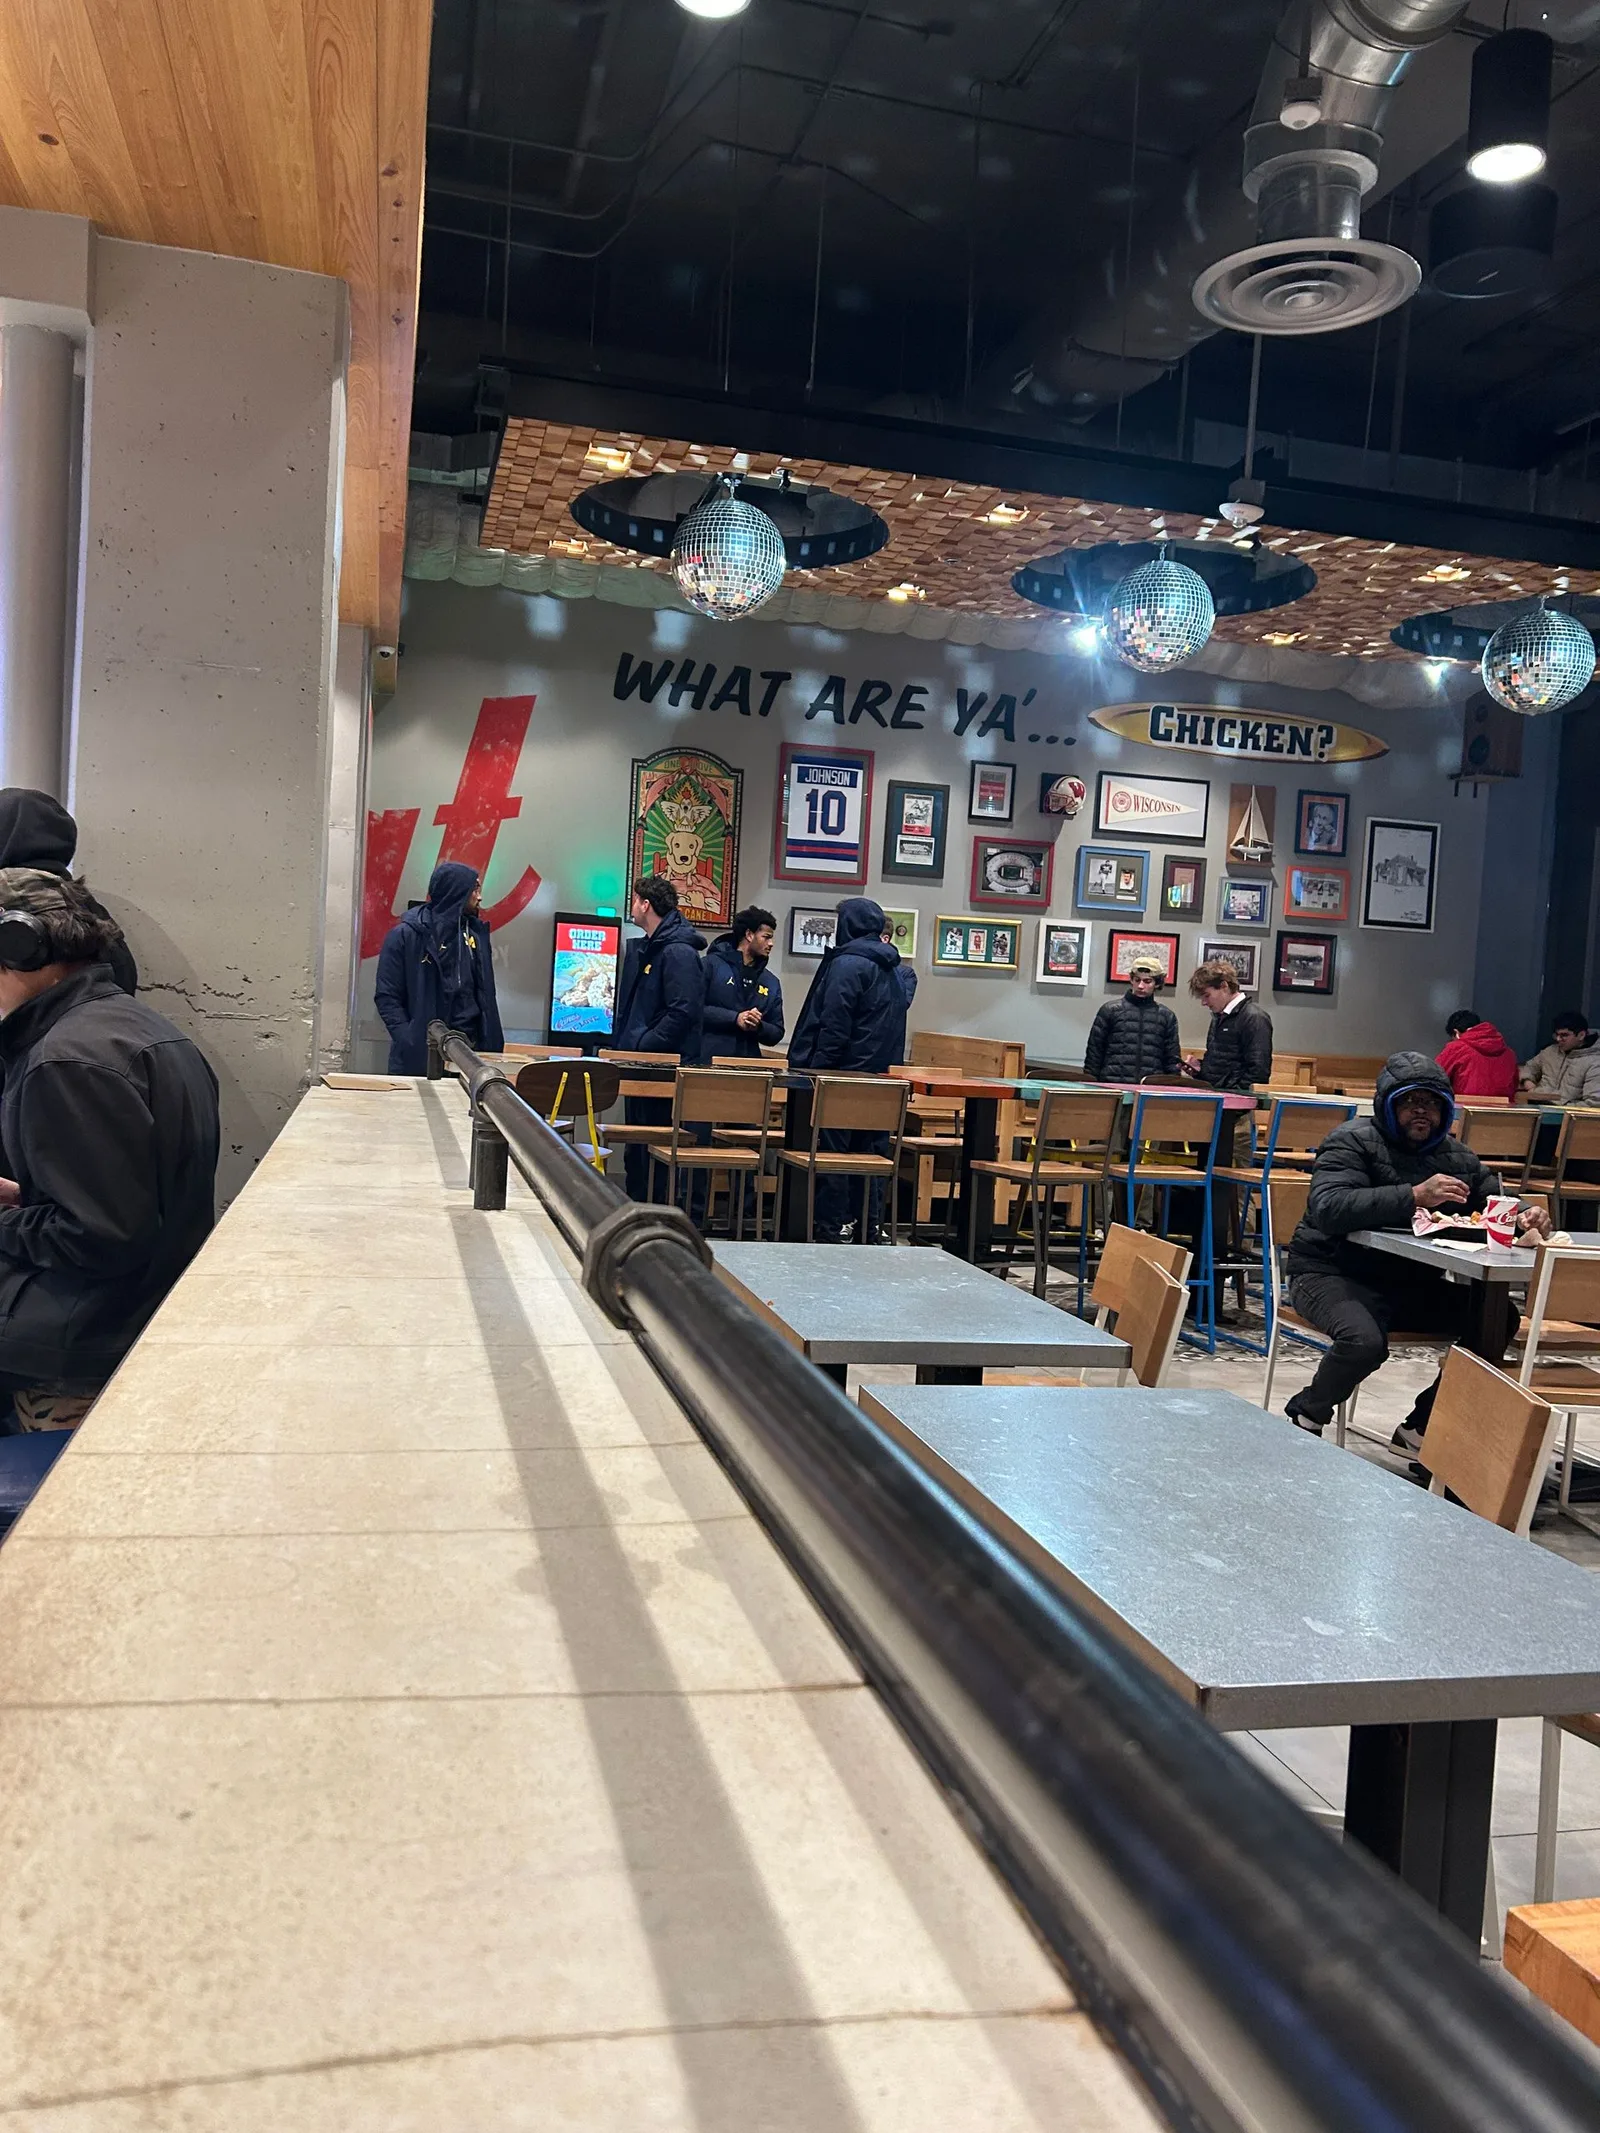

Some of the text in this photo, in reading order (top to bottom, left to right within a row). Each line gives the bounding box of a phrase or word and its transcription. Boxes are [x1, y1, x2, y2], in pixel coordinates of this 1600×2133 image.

[613, 652, 792, 717] WHAT
[805, 675, 930, 730] ARE
[1149, 705, 1335, 759] CHICKEN?
[664, 760, 681, 769] ONE
[804, 768, 851, 786] JOHNSON
[805, 788, 847, 836] 10
[1132, 794, 1182, 813] WISCONSIN
[569, 928, 607, 942] ORDER
[572, 939, 603, 952] HERE
